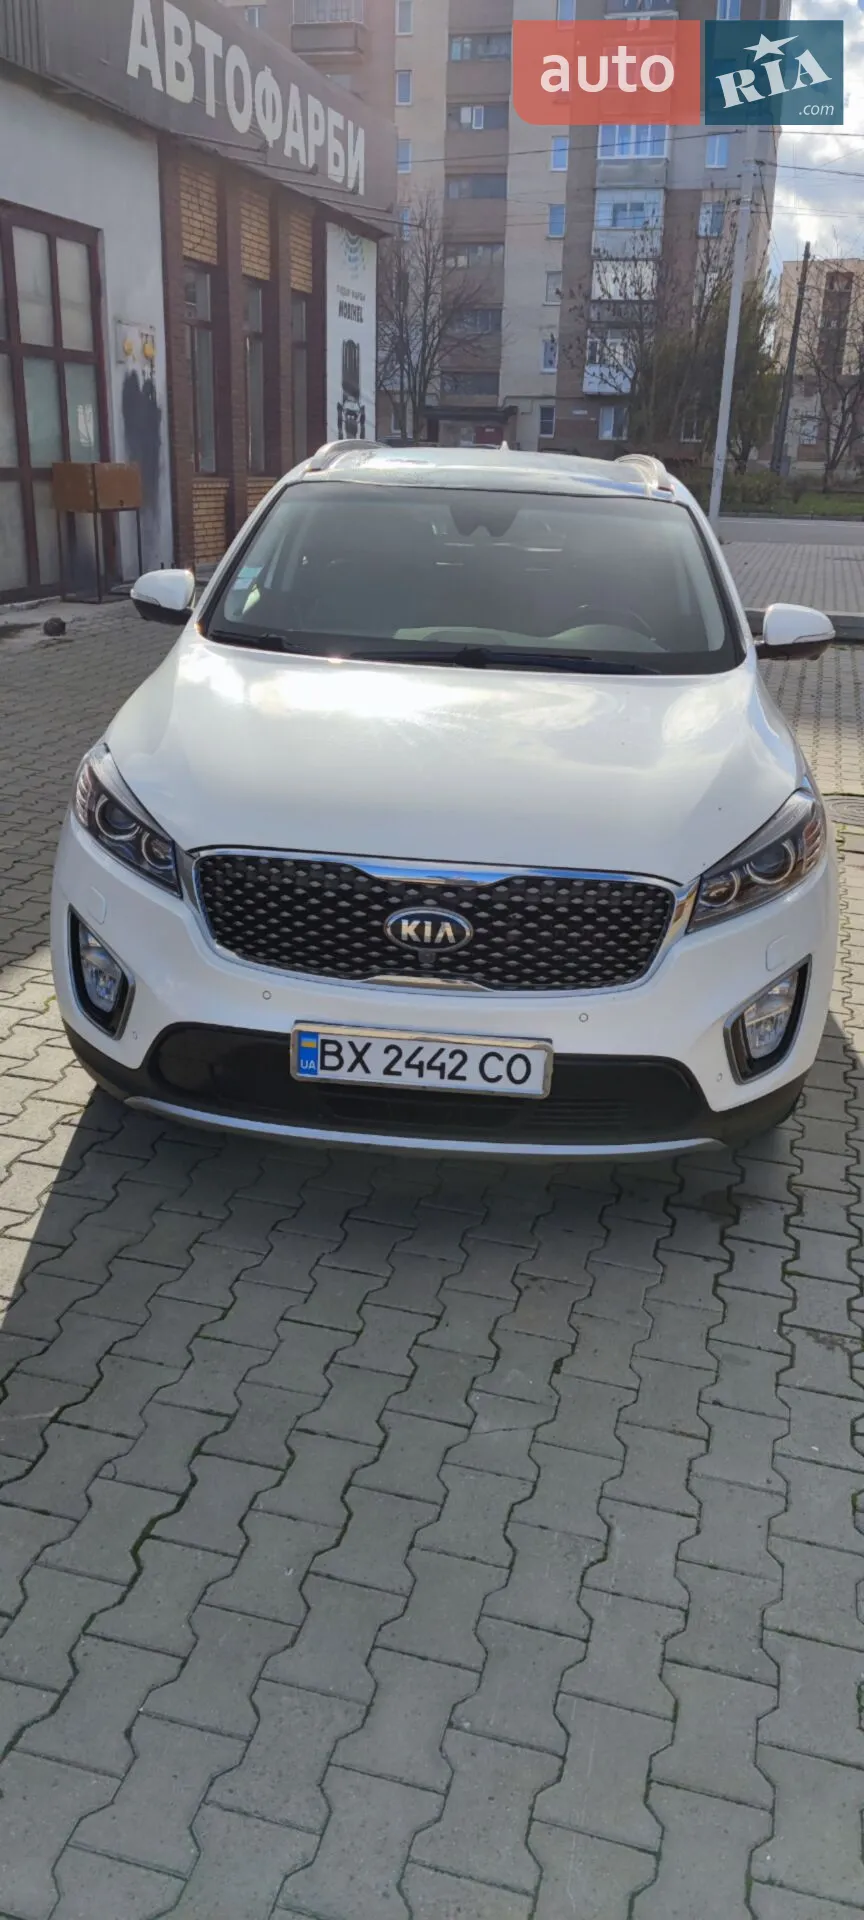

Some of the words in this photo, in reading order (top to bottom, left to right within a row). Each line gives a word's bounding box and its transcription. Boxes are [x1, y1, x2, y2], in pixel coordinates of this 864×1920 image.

[127, 0, 364, 195] АВТОФАРБИ
[400, 918, 457, 944] KIA
[300, 1059, 317, 1071] UA
[319, 1038, 373, 1074] BX
[382, 1043, 469, 1082] 2442
[478, 1051, 532, 1085] CO
